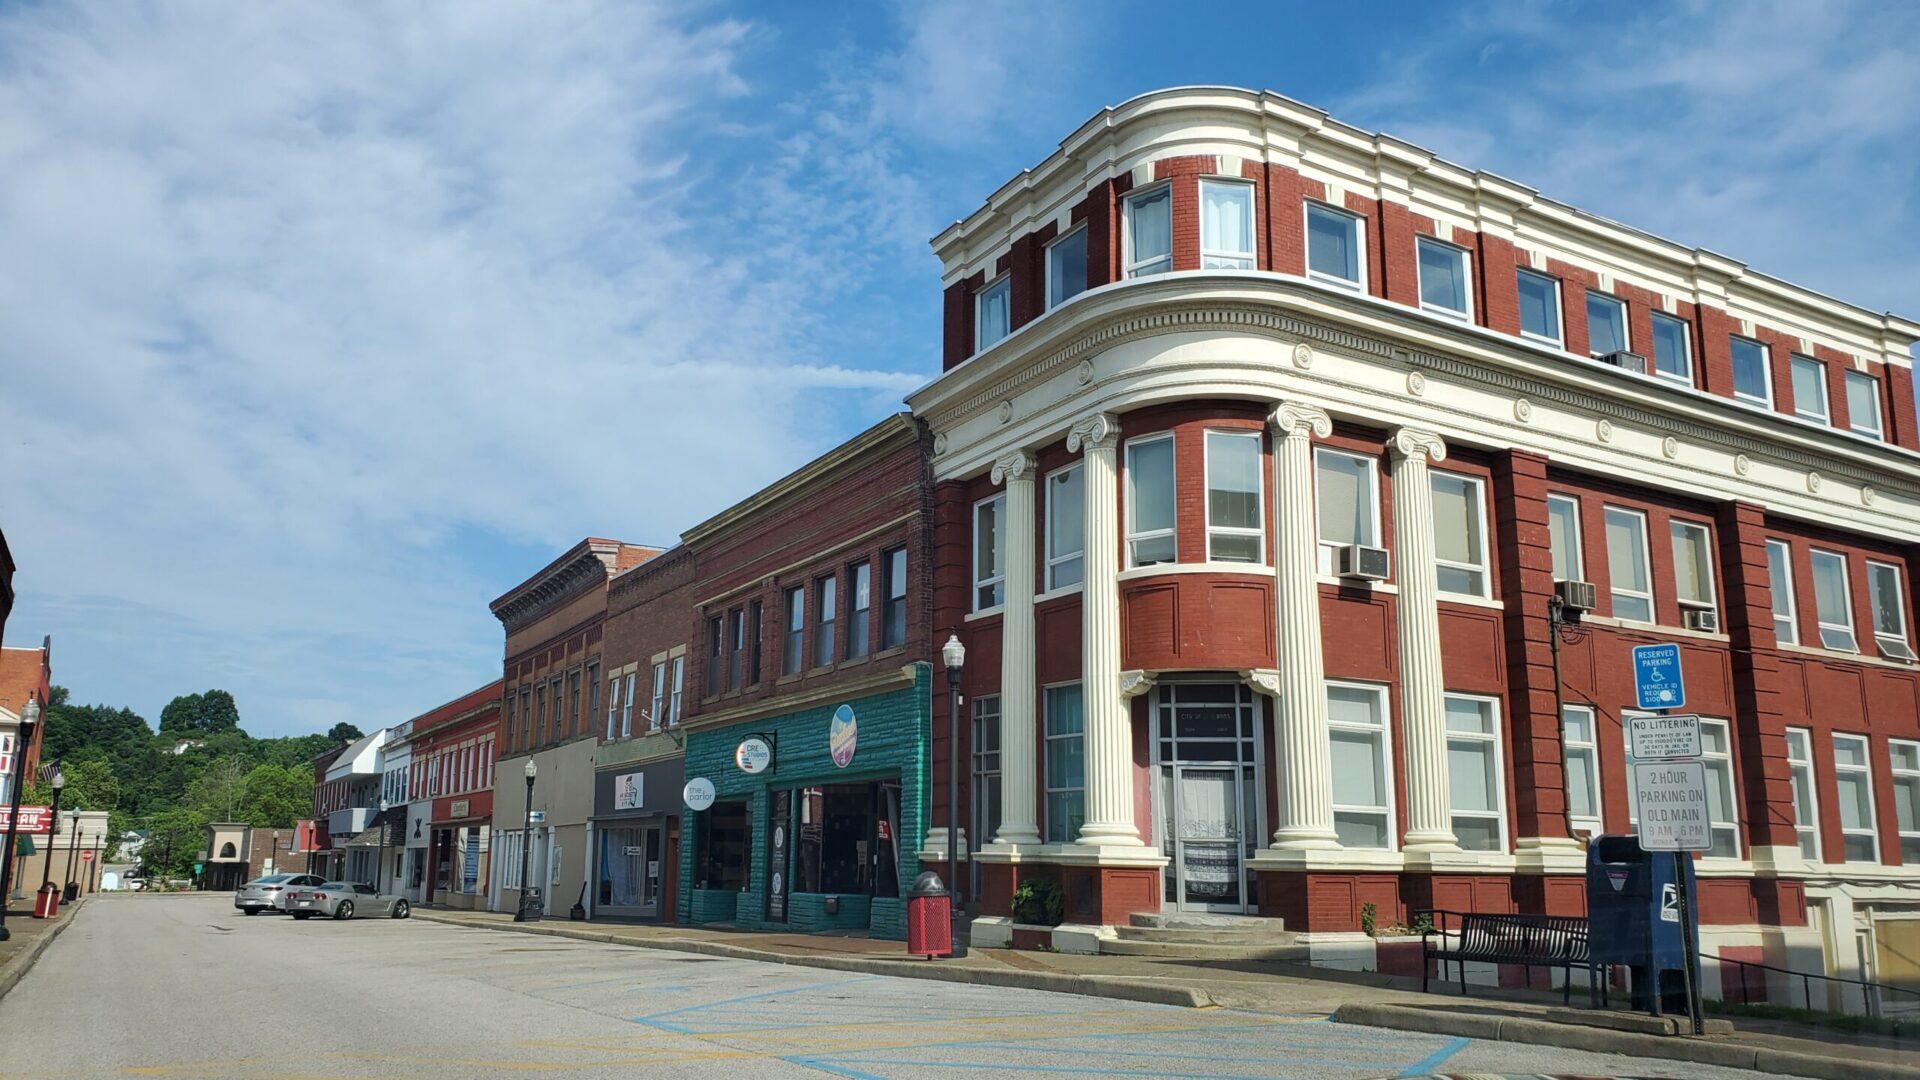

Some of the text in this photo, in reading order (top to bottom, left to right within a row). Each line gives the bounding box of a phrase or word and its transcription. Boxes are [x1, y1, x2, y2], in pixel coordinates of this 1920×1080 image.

[1638, 650, 1674, 659] RESERVED
[1642, 657, 1672, 667] PARKING
[1633, 719, 1695, 730] NO LITTERING
[1650, 771, 1688, 784] 2 HOUR
[689, 790, 713, 801] parlor
[1640, 789, 1703, 803] PARKING ON
[0, 813, 39, 825] LAN
[1648, 808, 1700, 822] OLD MAIN
[1657, 825, 1672, 836] AM
[1681, 825, 1686, 836] 6
[1689, 825, 1703, 836] PM
